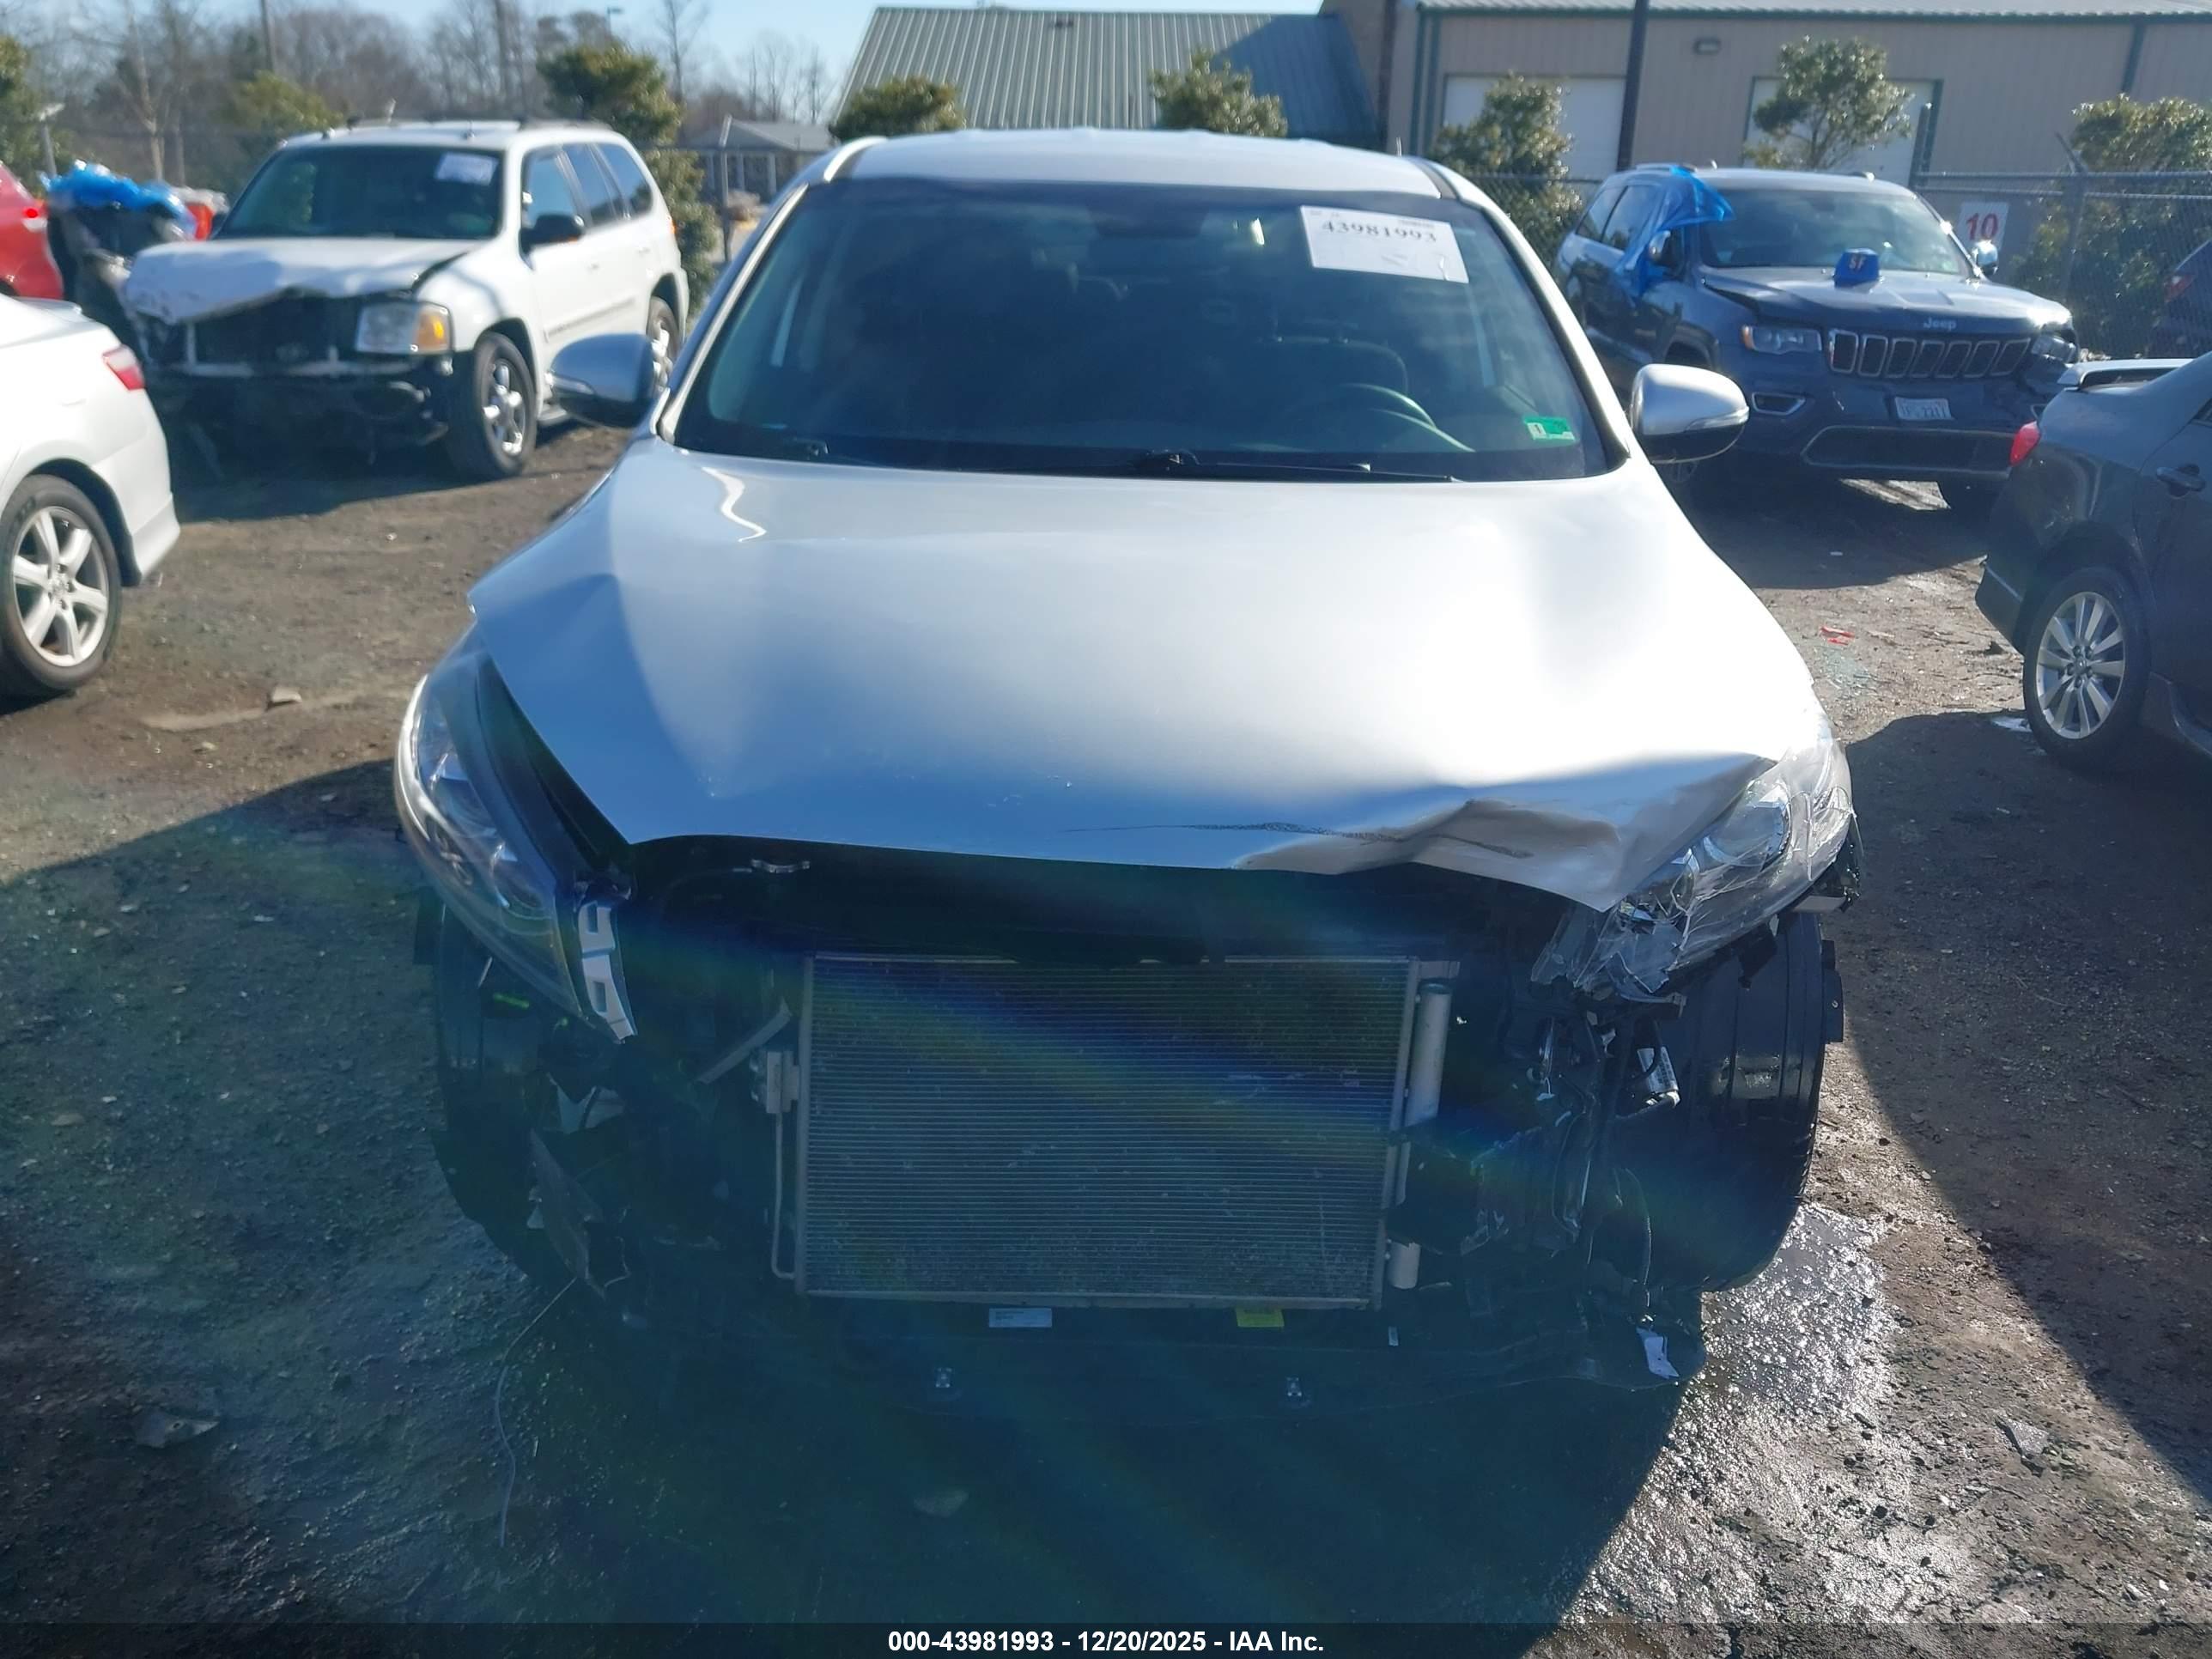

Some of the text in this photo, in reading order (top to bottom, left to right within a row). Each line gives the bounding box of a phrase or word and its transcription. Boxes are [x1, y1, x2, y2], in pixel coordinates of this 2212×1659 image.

[1322, 221, 1437, 243] 43981993
[1966, 212, 1999, 240] 10
[1923, 317, 1956, 331] Jeep
